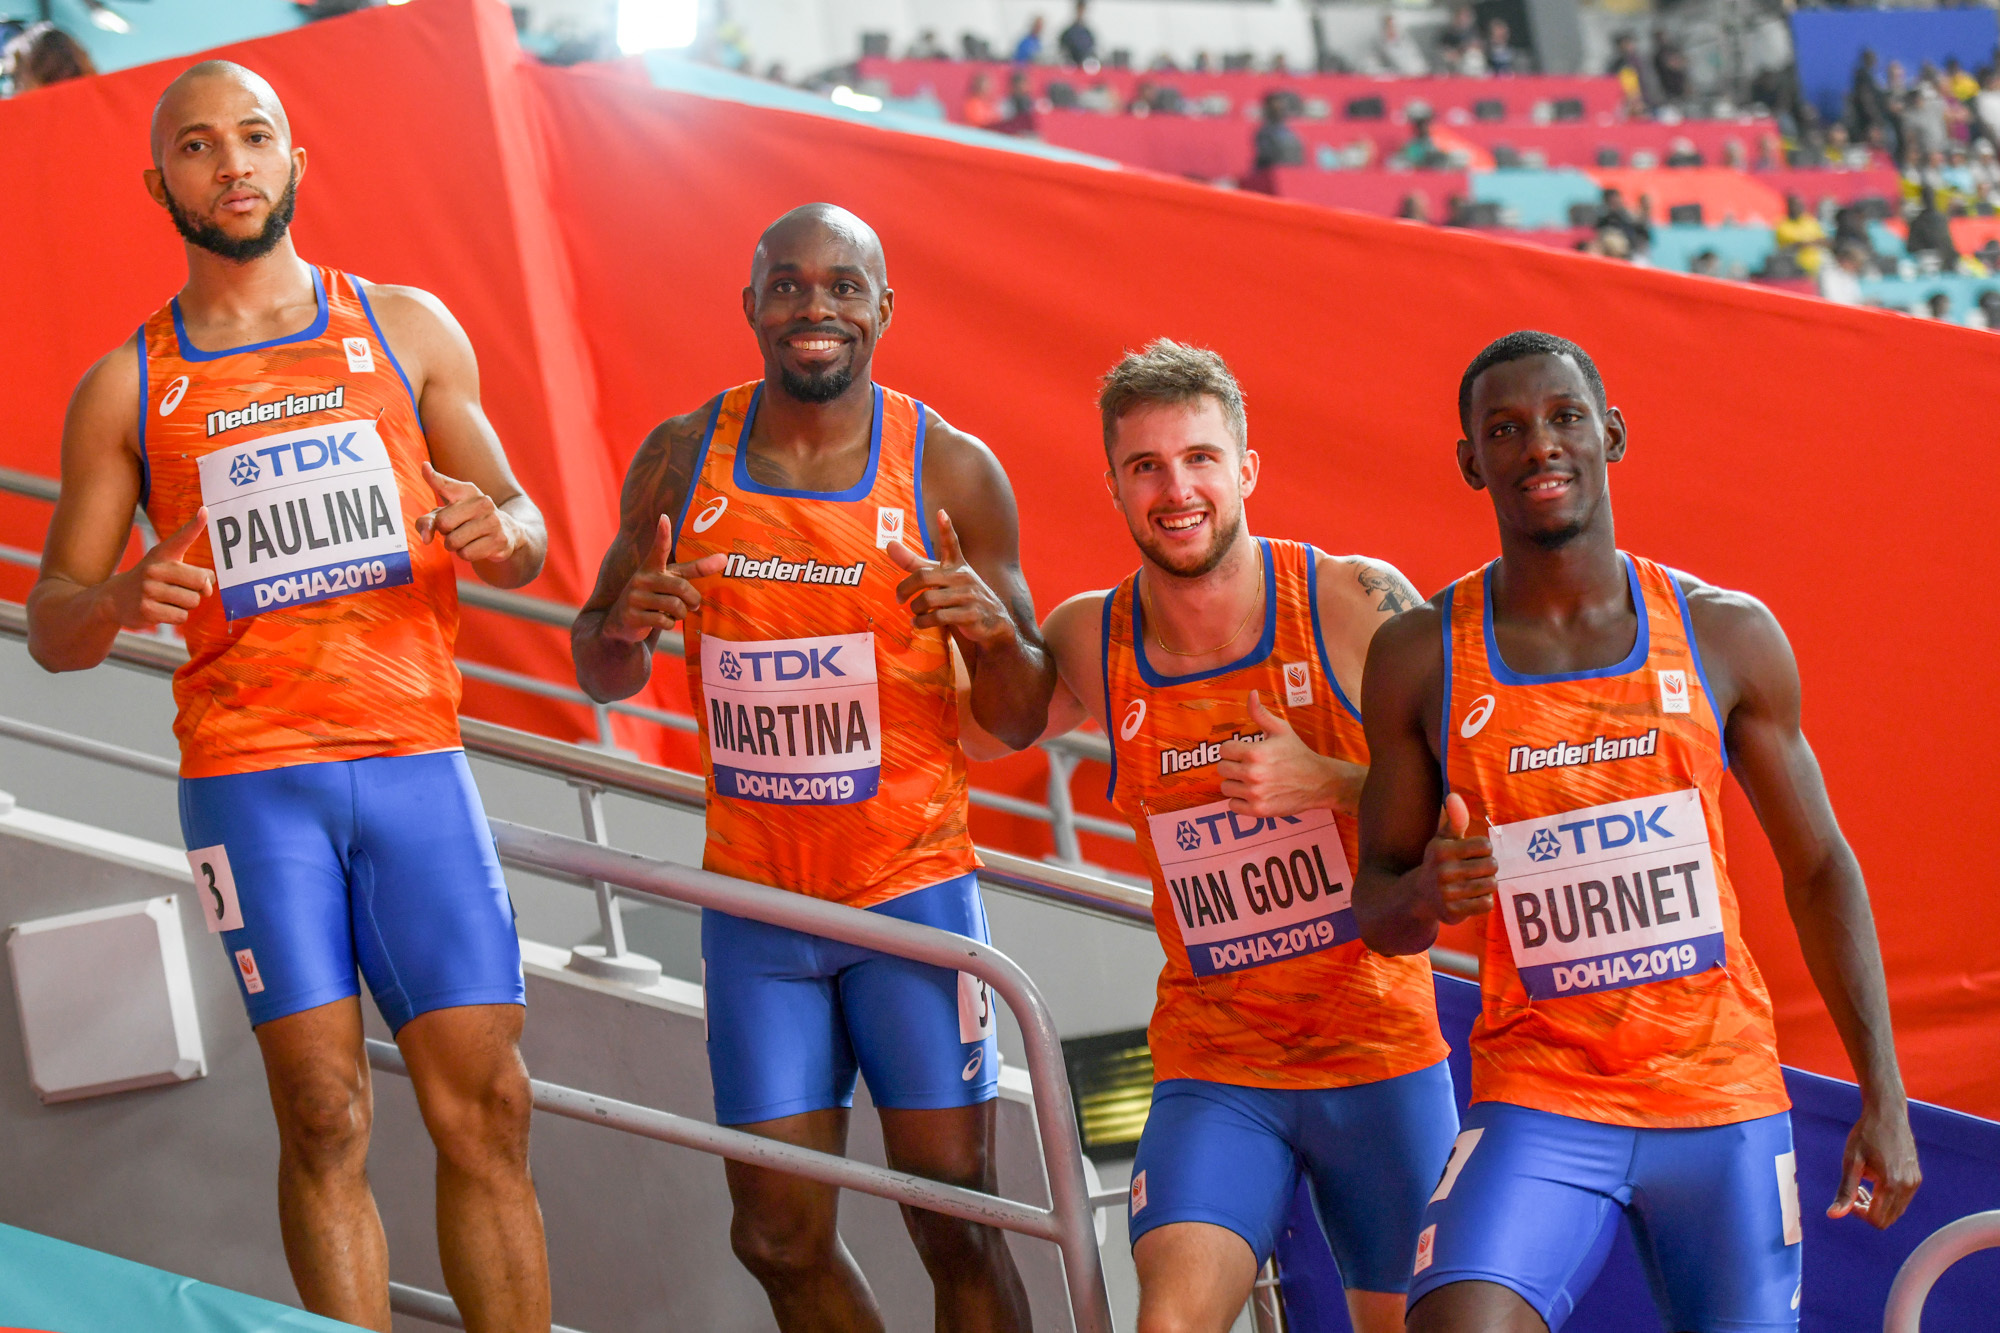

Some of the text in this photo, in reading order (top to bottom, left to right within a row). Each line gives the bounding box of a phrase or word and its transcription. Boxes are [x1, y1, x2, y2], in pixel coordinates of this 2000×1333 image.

[256, 432, 364, 477] TDK
[216, 485, 396, 570] PAULINA
[253, 561, 387, 608] DOHA2019
[740, 646, 847, 682] TDK
[710, 697, 872, 757] MARTINA
[735, 773, 855, 800] DOHA2019
[1557, 805, 1675, 854] TDK
[200, 862, 225, 920] 3
[1170, 845, 1344, 929] VAN GOOL
[1512, 860, 1701, 949] BURNET
[1209, 920, 1335, 970] DOHA2019
[1552, 944, 1697, 992] DOHA2019
